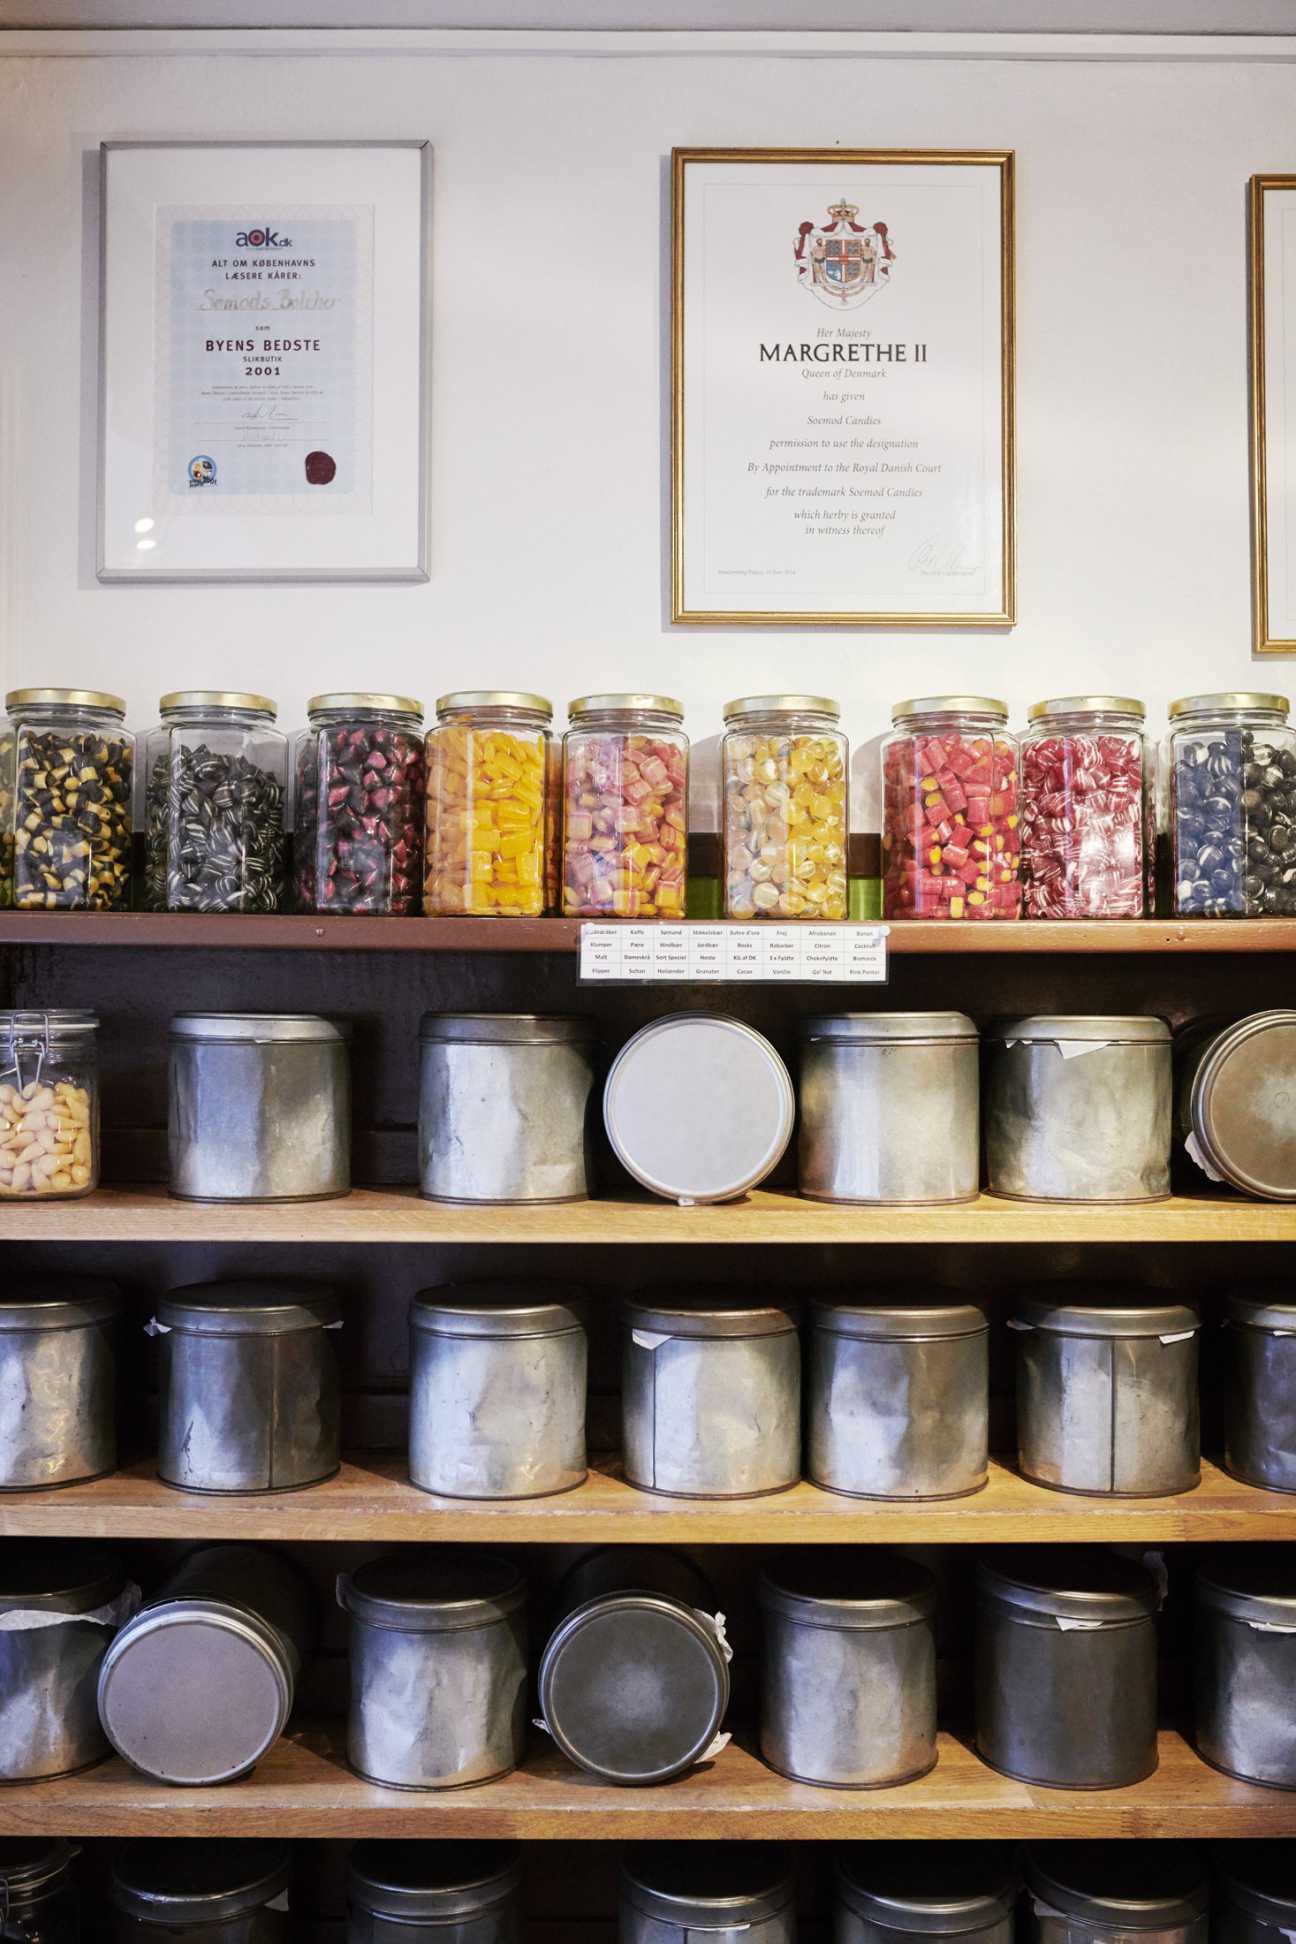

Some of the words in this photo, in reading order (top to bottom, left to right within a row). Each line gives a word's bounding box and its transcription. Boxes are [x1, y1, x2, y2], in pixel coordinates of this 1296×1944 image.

[211, 259, 228, 268] ALT
[232, 259, 248, 268] OM
[252, 259, 316, 268] KØBENHAVNS
[225, 272, 263, 280] LÆSERE
[816, 327, 833, 338] Her
[836, 327, 871, 340] Majesty
[205, 339, 255, 352] BYENS
[263, 339, 321, 352] BEDSTE
[759, 343, 907, 362] MARGRETHE
[914, 343, 928, 362] II
[245, 367, 281, 376] 2001
[801, 368, 830, 379] Queen
[832, 368, 842, 380] of
[844, 368, 887, 378] Denmark
[822, 390, 839, 401] has
[840, 391, 865, 404] given
[806, 415, 843, 425] Soemod
[845, 415, 882, 425] Candies
[769, 439, 819, 450] permission
[821, 440, 831, 448] to
[833, 440, 847, 448] use
[850, 438, 864, 448] the
[866, 438, 919, 450] designation
[747, 462, 759, 475] By
[761, 462, 822, 475] Appointment
[824, 463, 834, 473] to
[836, 462, 850, 473] the
[852, 462, 879, 475] Royal
[881, 462, 913, 473] Danish
[915, 462, 941, 473] Court
[765, 486, 780, 499] for
[782, 486, 796, 497] the
[798, 486, 846, 497] trademark
[849, 486, 885, 497] Soemod
[887, 486, 923, 497] Candies
[794, 509, 821, 520] which
[823, 509, 849, 522] herby
[851, 510, 858, 520] is
[859, 509, 897, 522] granted
[805, 526, 815, 535] in
[818, 525, 850, 535] witness
[852, 525, 885, 537] thereof
